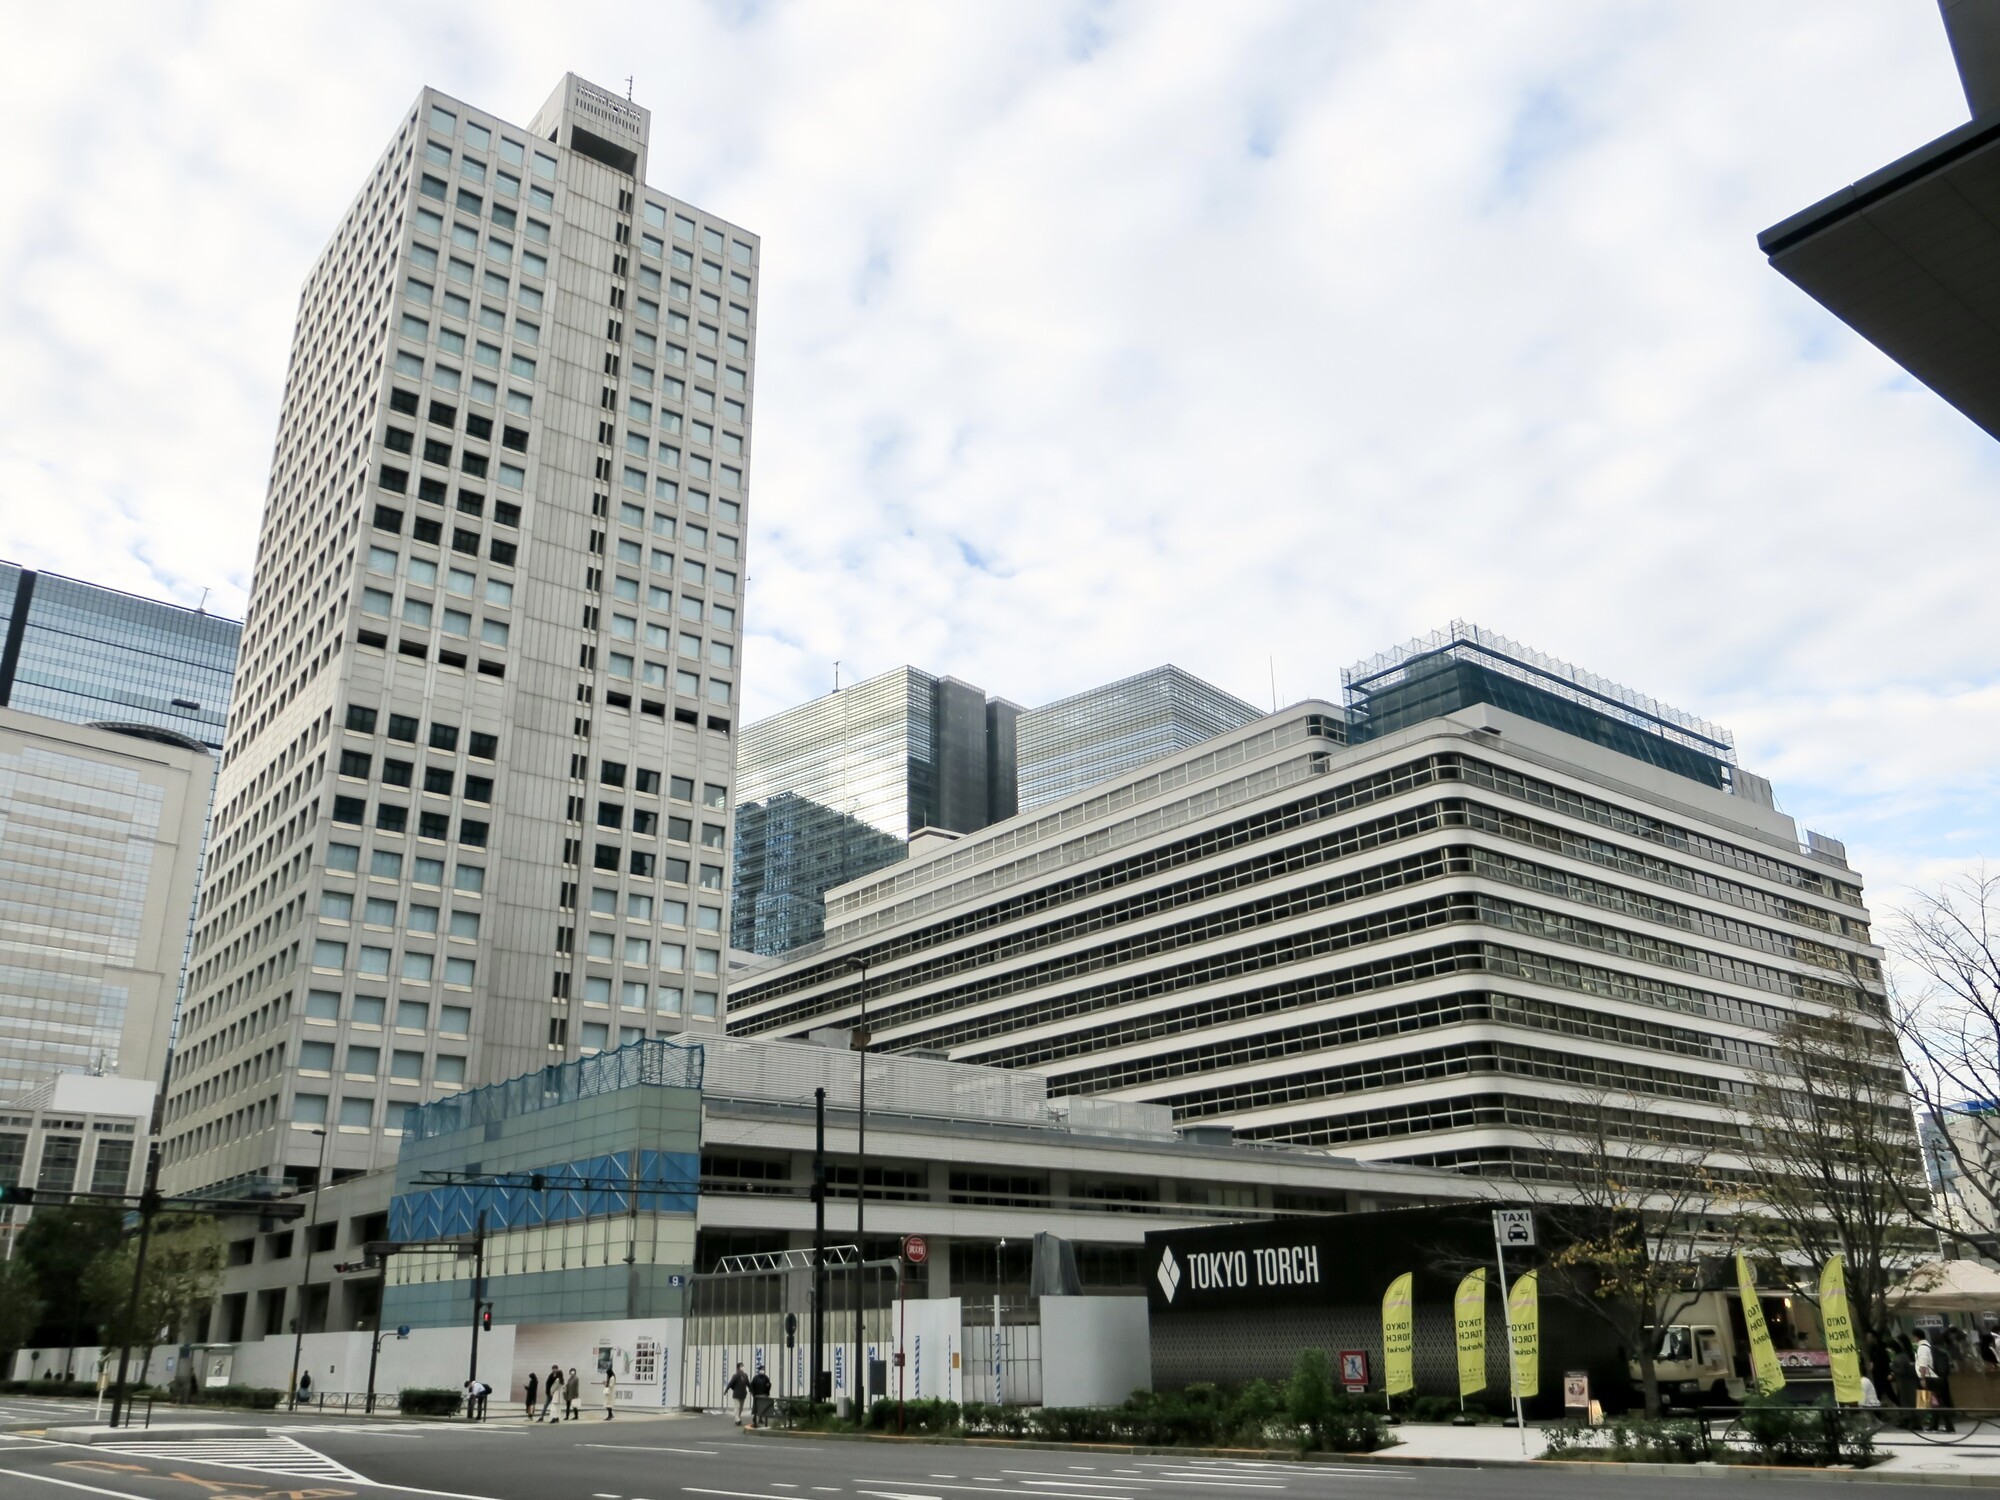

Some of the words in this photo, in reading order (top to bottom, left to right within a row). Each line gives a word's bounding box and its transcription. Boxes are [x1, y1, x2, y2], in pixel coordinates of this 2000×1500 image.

[1501, 1213, 1529, 1222] TAXI
[1187, 1250, 1247, 1289] TOKYO
[1253, 1245, 1319, 1286] TORCH
[672, 1276, 679, 1286] 9
